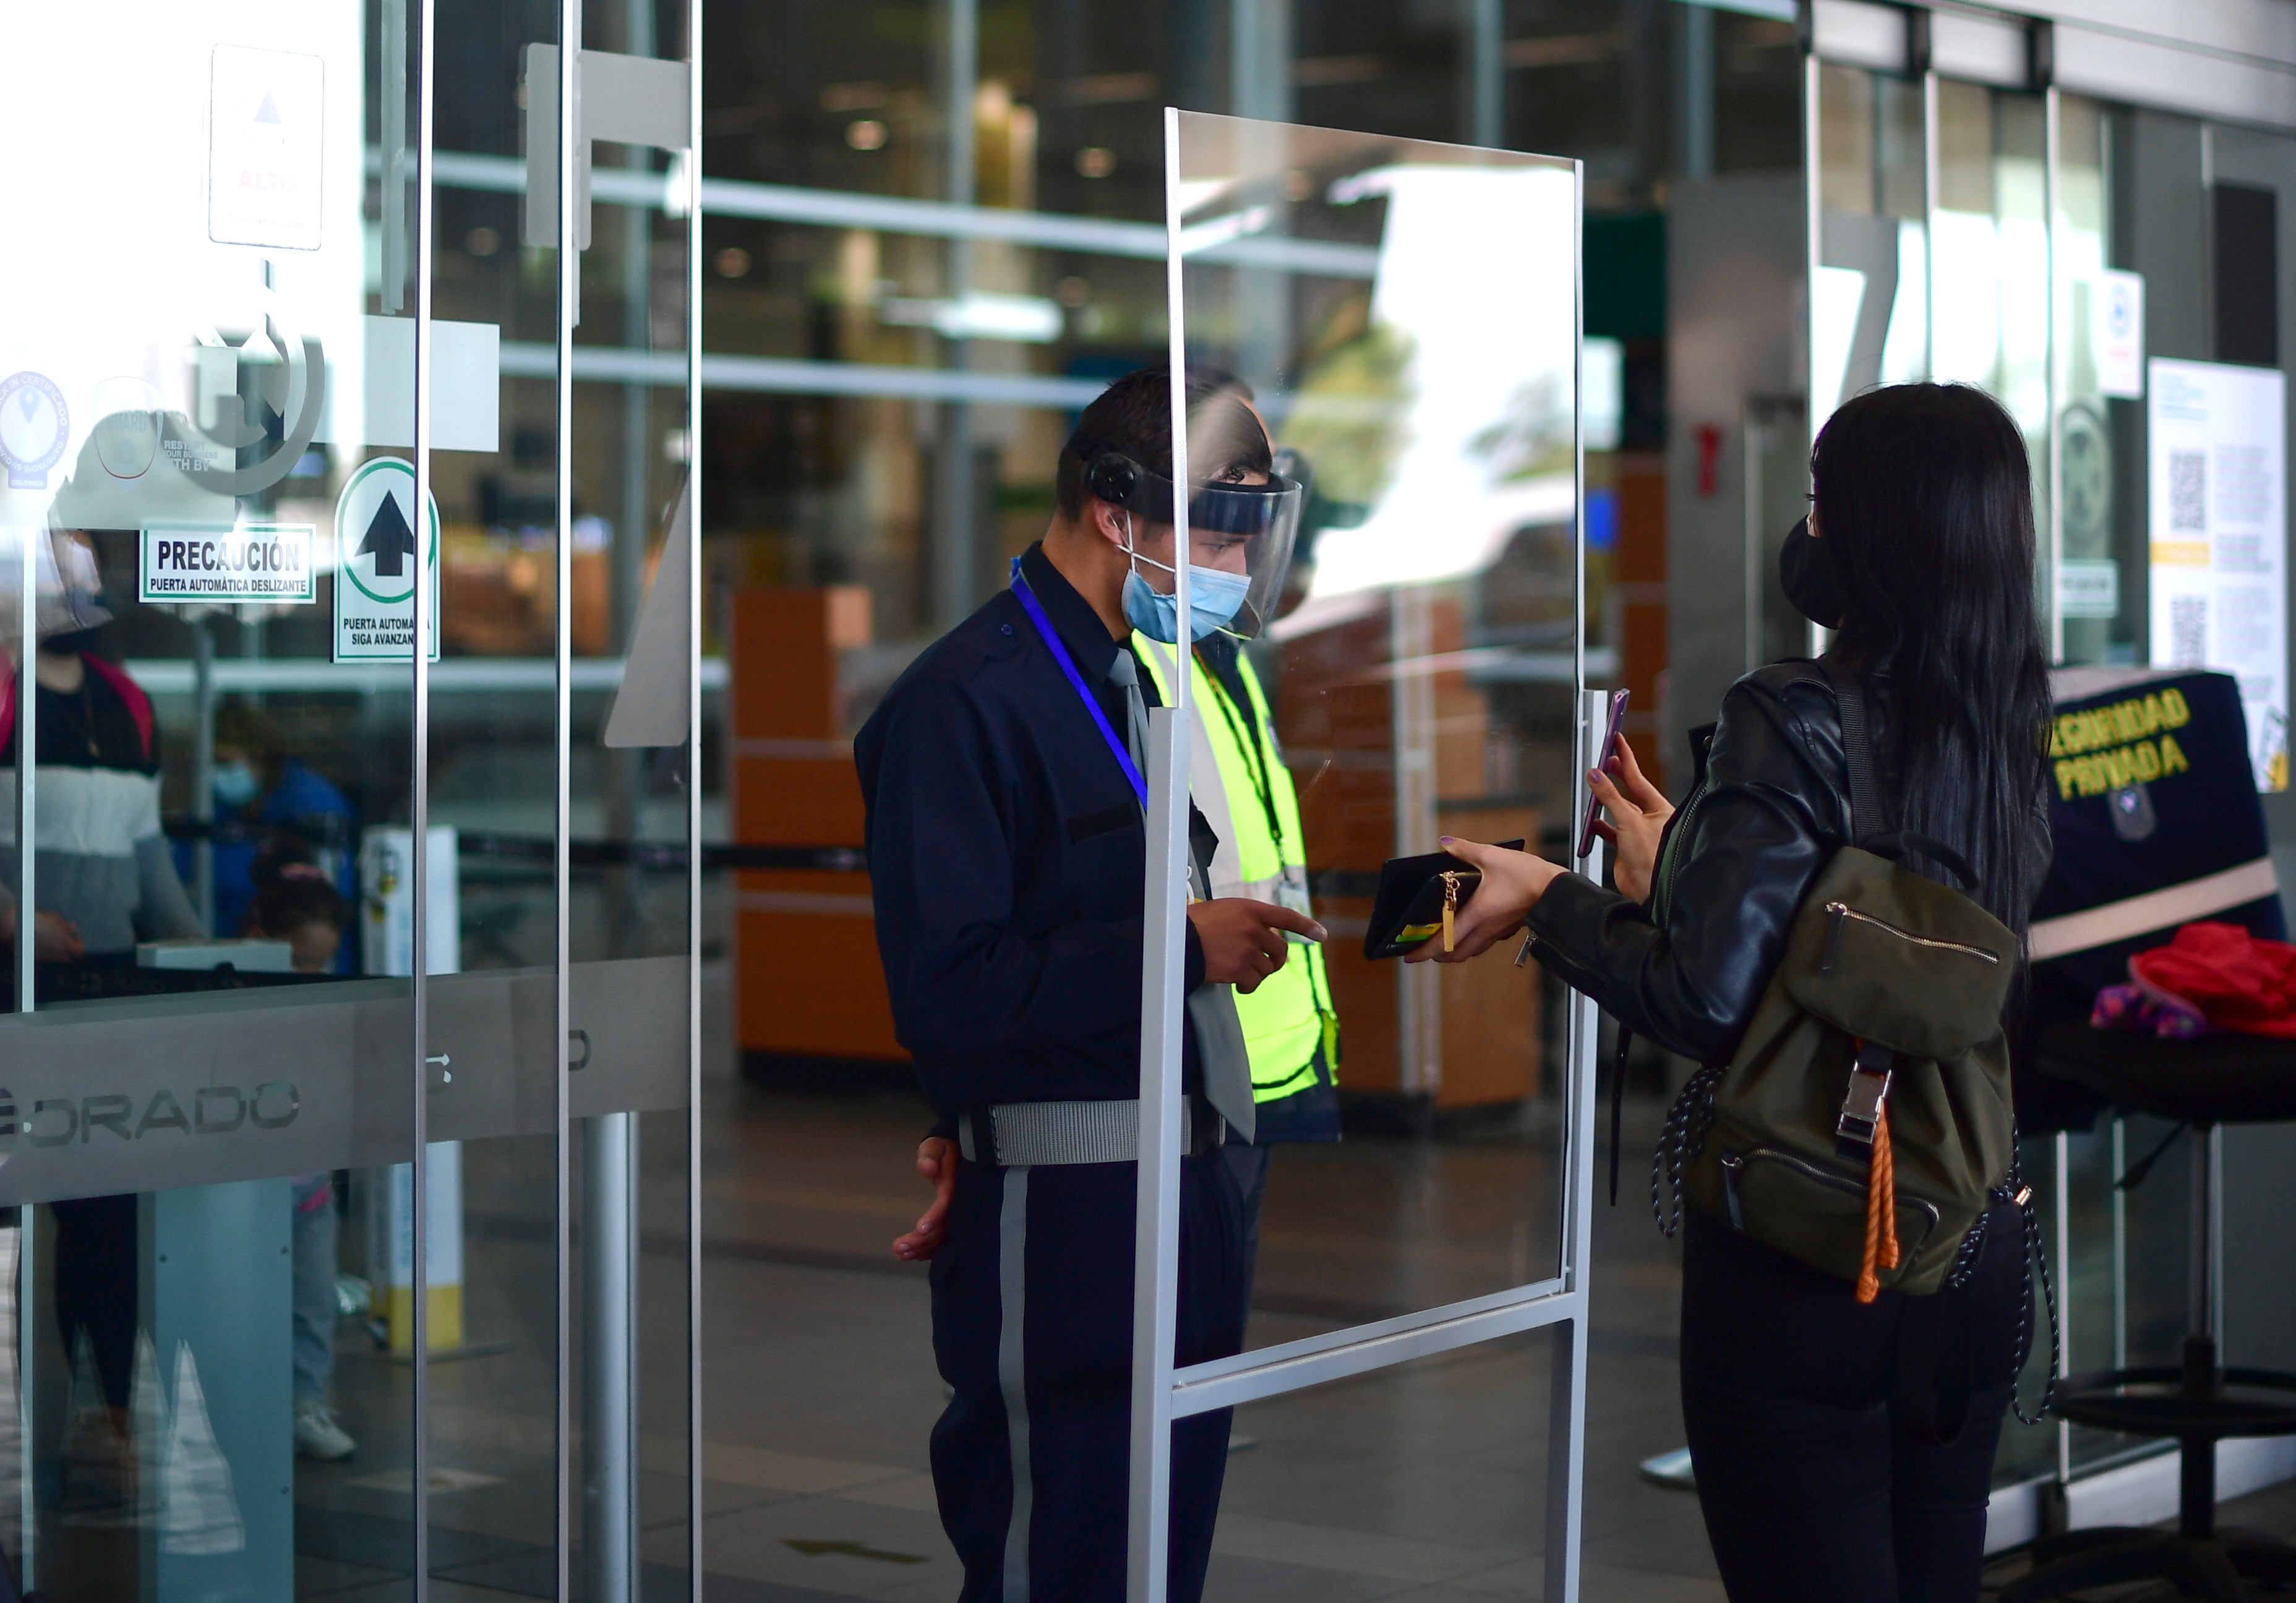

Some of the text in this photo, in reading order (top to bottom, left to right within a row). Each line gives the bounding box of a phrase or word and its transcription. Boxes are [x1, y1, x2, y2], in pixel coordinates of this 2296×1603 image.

[238, 168, 297, 192] ALTO
[9, 377, 19, 388] IN
[21, 375, 67, 427] CERTIFICADO
[11, 479, 44, 487] COLOMBIA
[158, 536, 299, 571] PRECAUCIÓN
[150, 576, 306, 592] PUERTA AUTOMÁTICA DESLIZANTE
[343, 615, 430, 630] PUERTA AUTOMÁ
[352, 633, 414, 645] SIGA AVANZAN
[2049, 688, 2191, 757] EGURIDAD
[2054, 733, 2189, 801] PRIVADA
